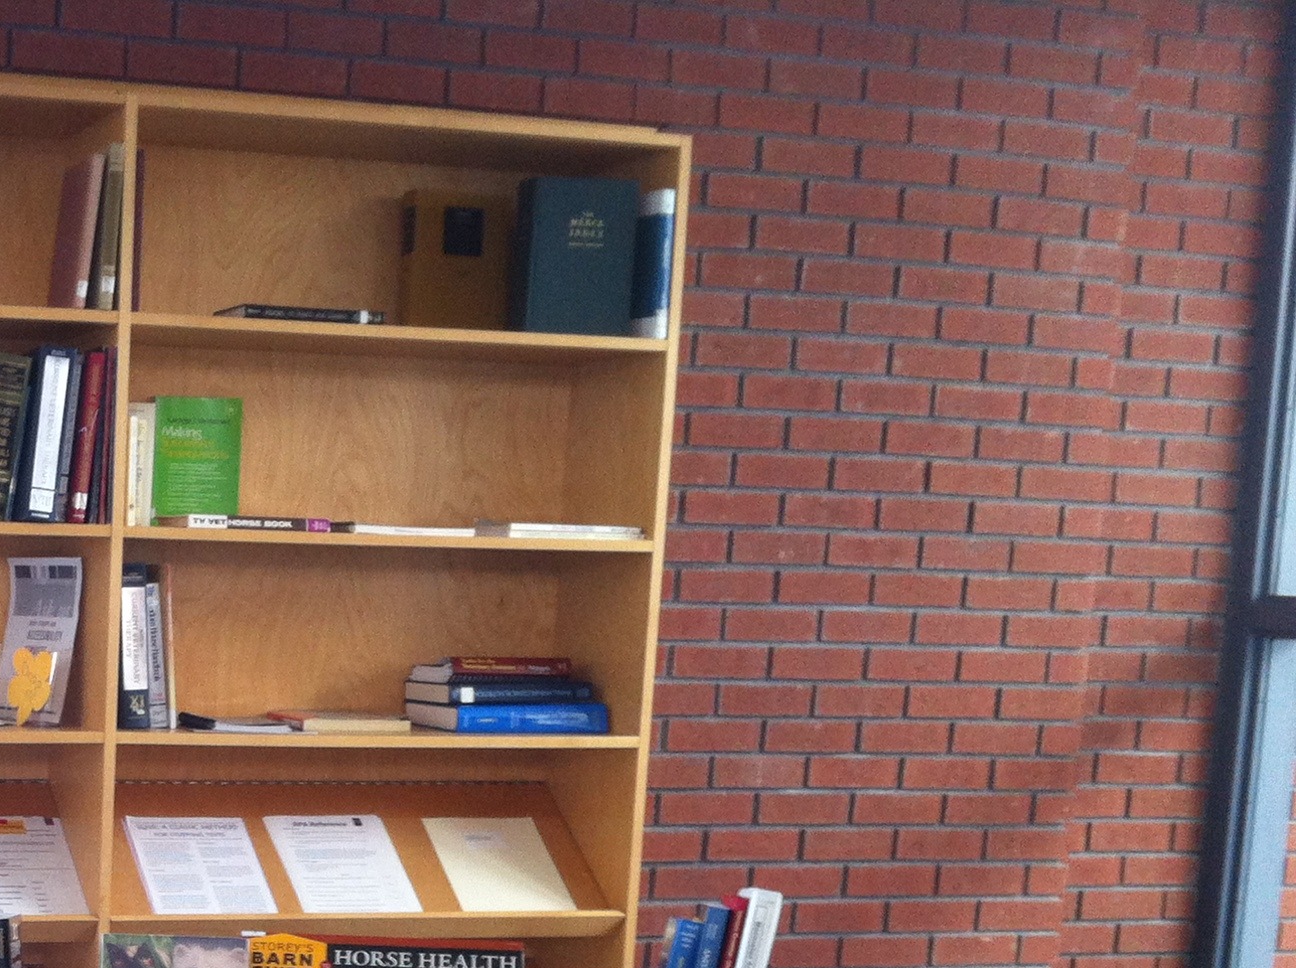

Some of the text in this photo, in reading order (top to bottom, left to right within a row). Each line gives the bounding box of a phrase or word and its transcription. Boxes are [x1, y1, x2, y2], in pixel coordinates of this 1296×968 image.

[263, 520, 293, 529] BOOK
[251, 952, 313, 966] BARN
[333, 950, 413, 968] HORSE
